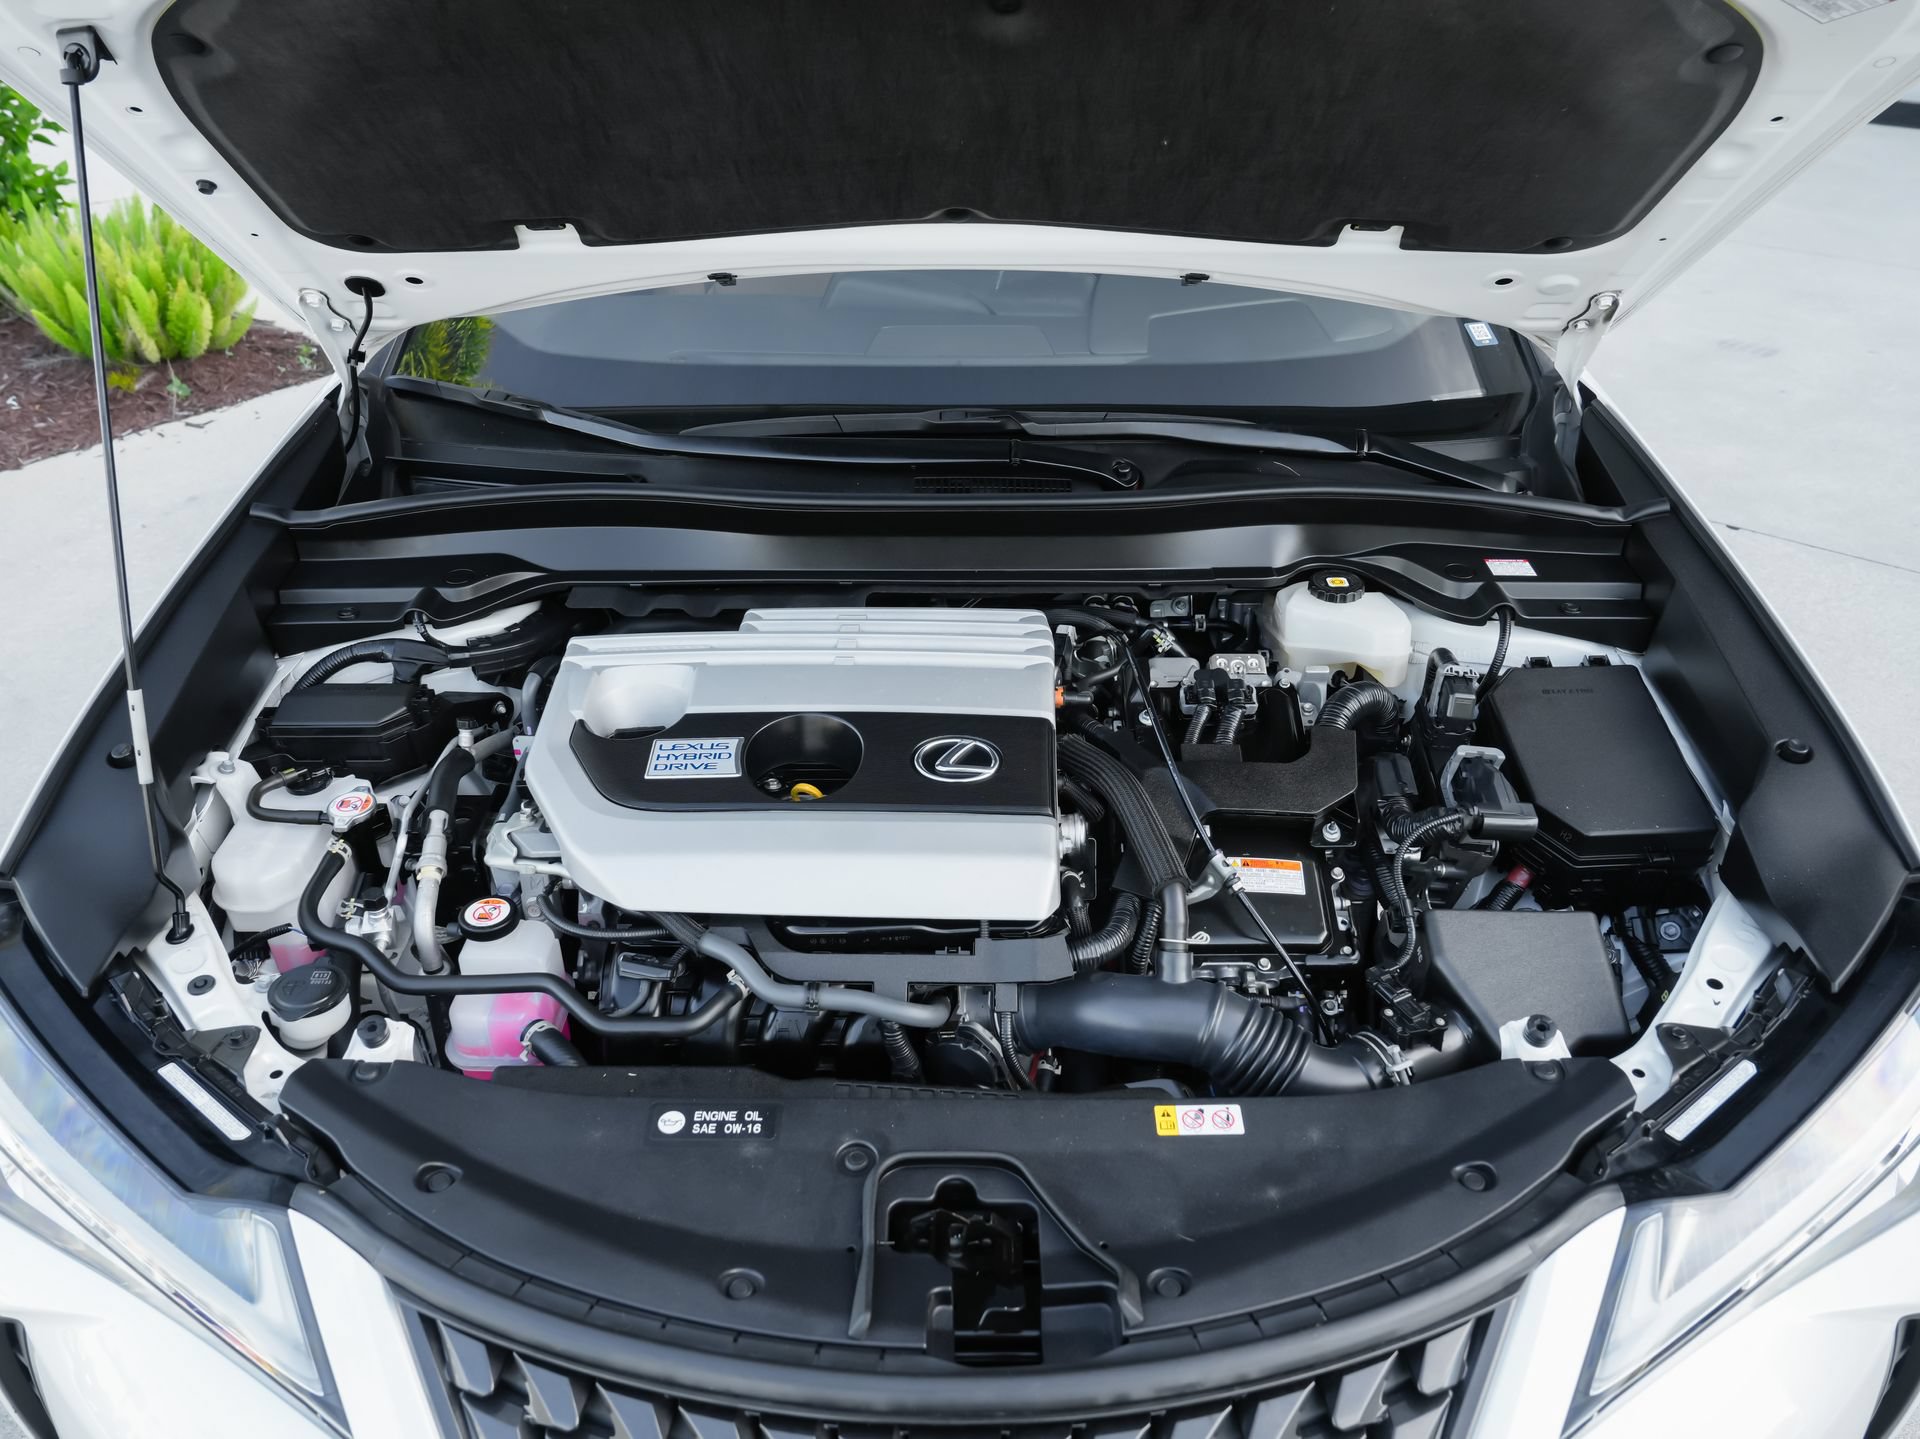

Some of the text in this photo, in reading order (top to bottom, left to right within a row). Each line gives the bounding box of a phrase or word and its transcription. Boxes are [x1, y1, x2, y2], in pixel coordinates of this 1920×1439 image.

[659, 742, 730, 751] LEXUS
[656, 752, 732, 761] HYBRID
[653, 762, 719, 771] DRIVE
[693, 1110, 763, 1121] ENGINE OIL
[691, 1123, 762, 1134] SAE 0W-16
